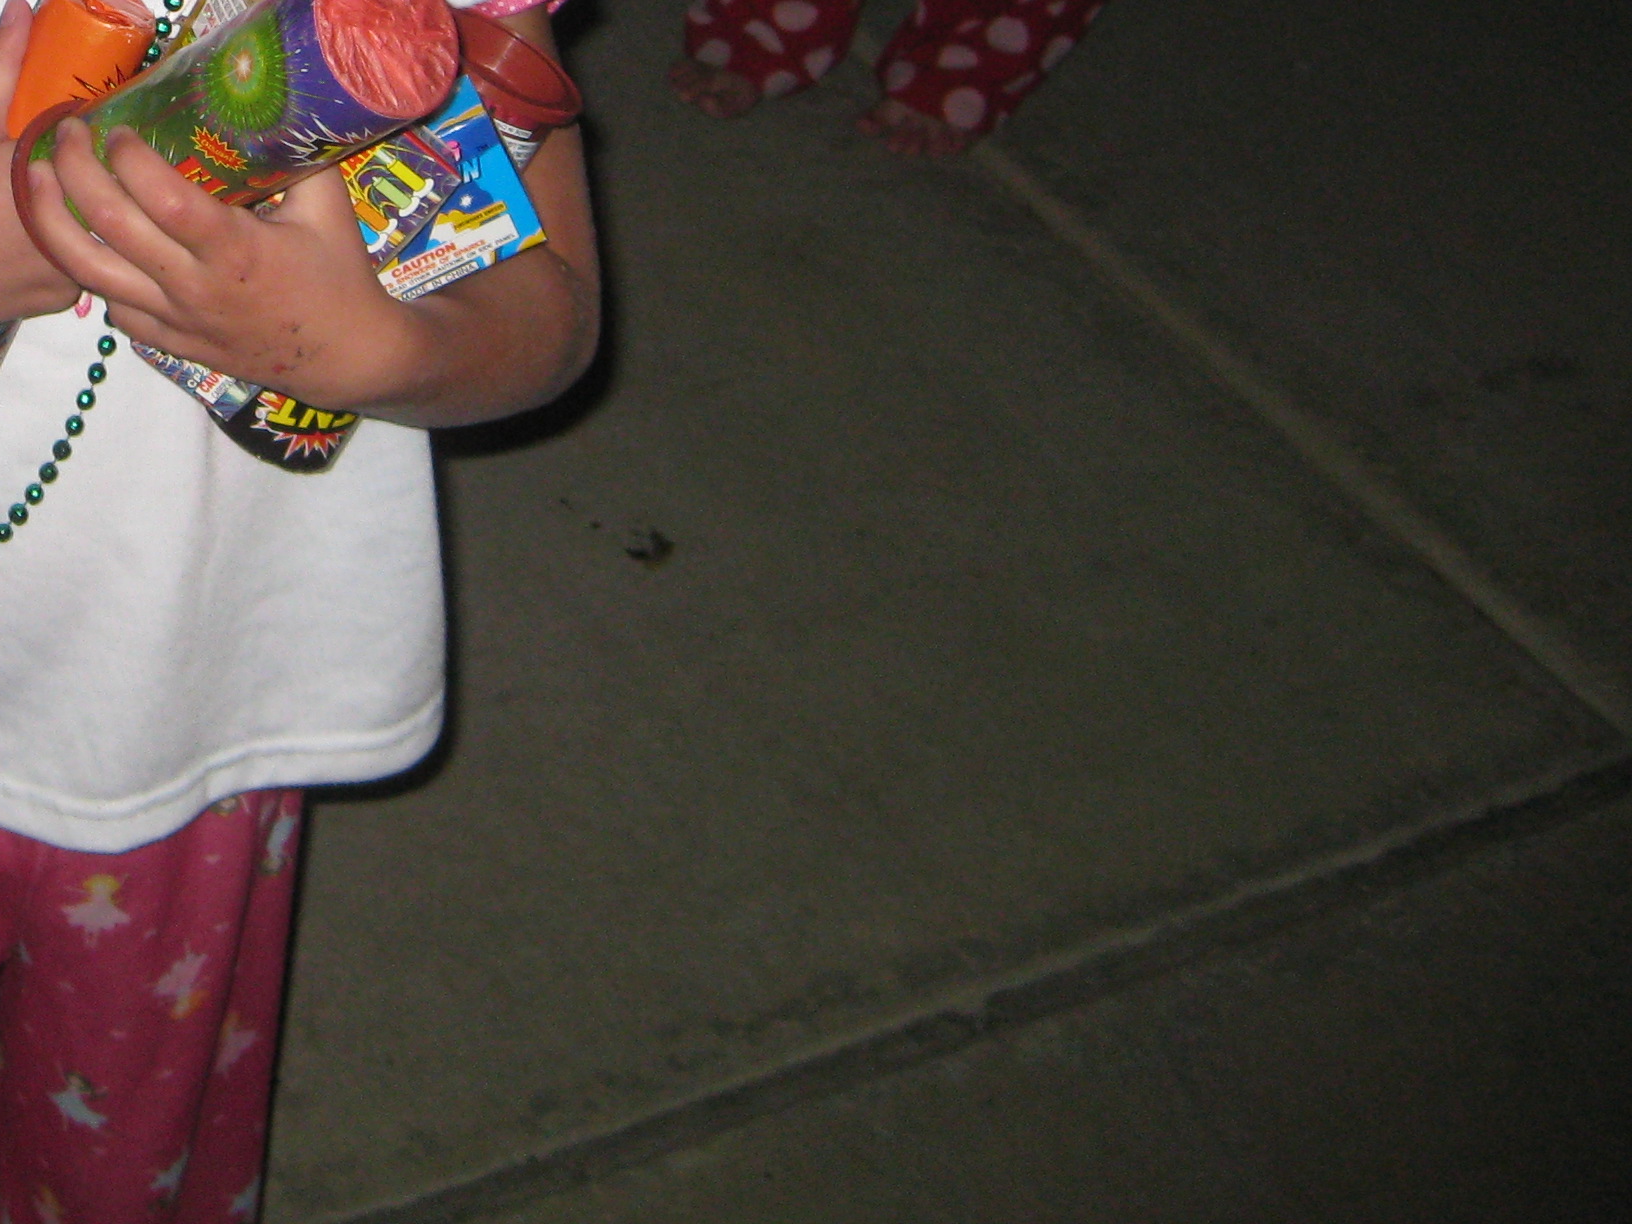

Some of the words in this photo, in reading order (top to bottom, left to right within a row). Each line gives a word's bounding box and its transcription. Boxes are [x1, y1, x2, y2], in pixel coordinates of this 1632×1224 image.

[388, 282, 407, 295] READ
[408, 271, 431, 286] OTHER
[431, 255, 465, 274] CAUTIONS
[466, 249, 477, 259] ON
[390, 242, 457, 278] CAUTION
[395, 261, 437, 284] SHOWERS
[438, 254, 451, 265] OF
[452, 238, 486, 258] SPARKS
[400, 283, 428, 302] MADE
[431, 277, 443, 288] IN
[444, 262, 476, 282] CHINA
